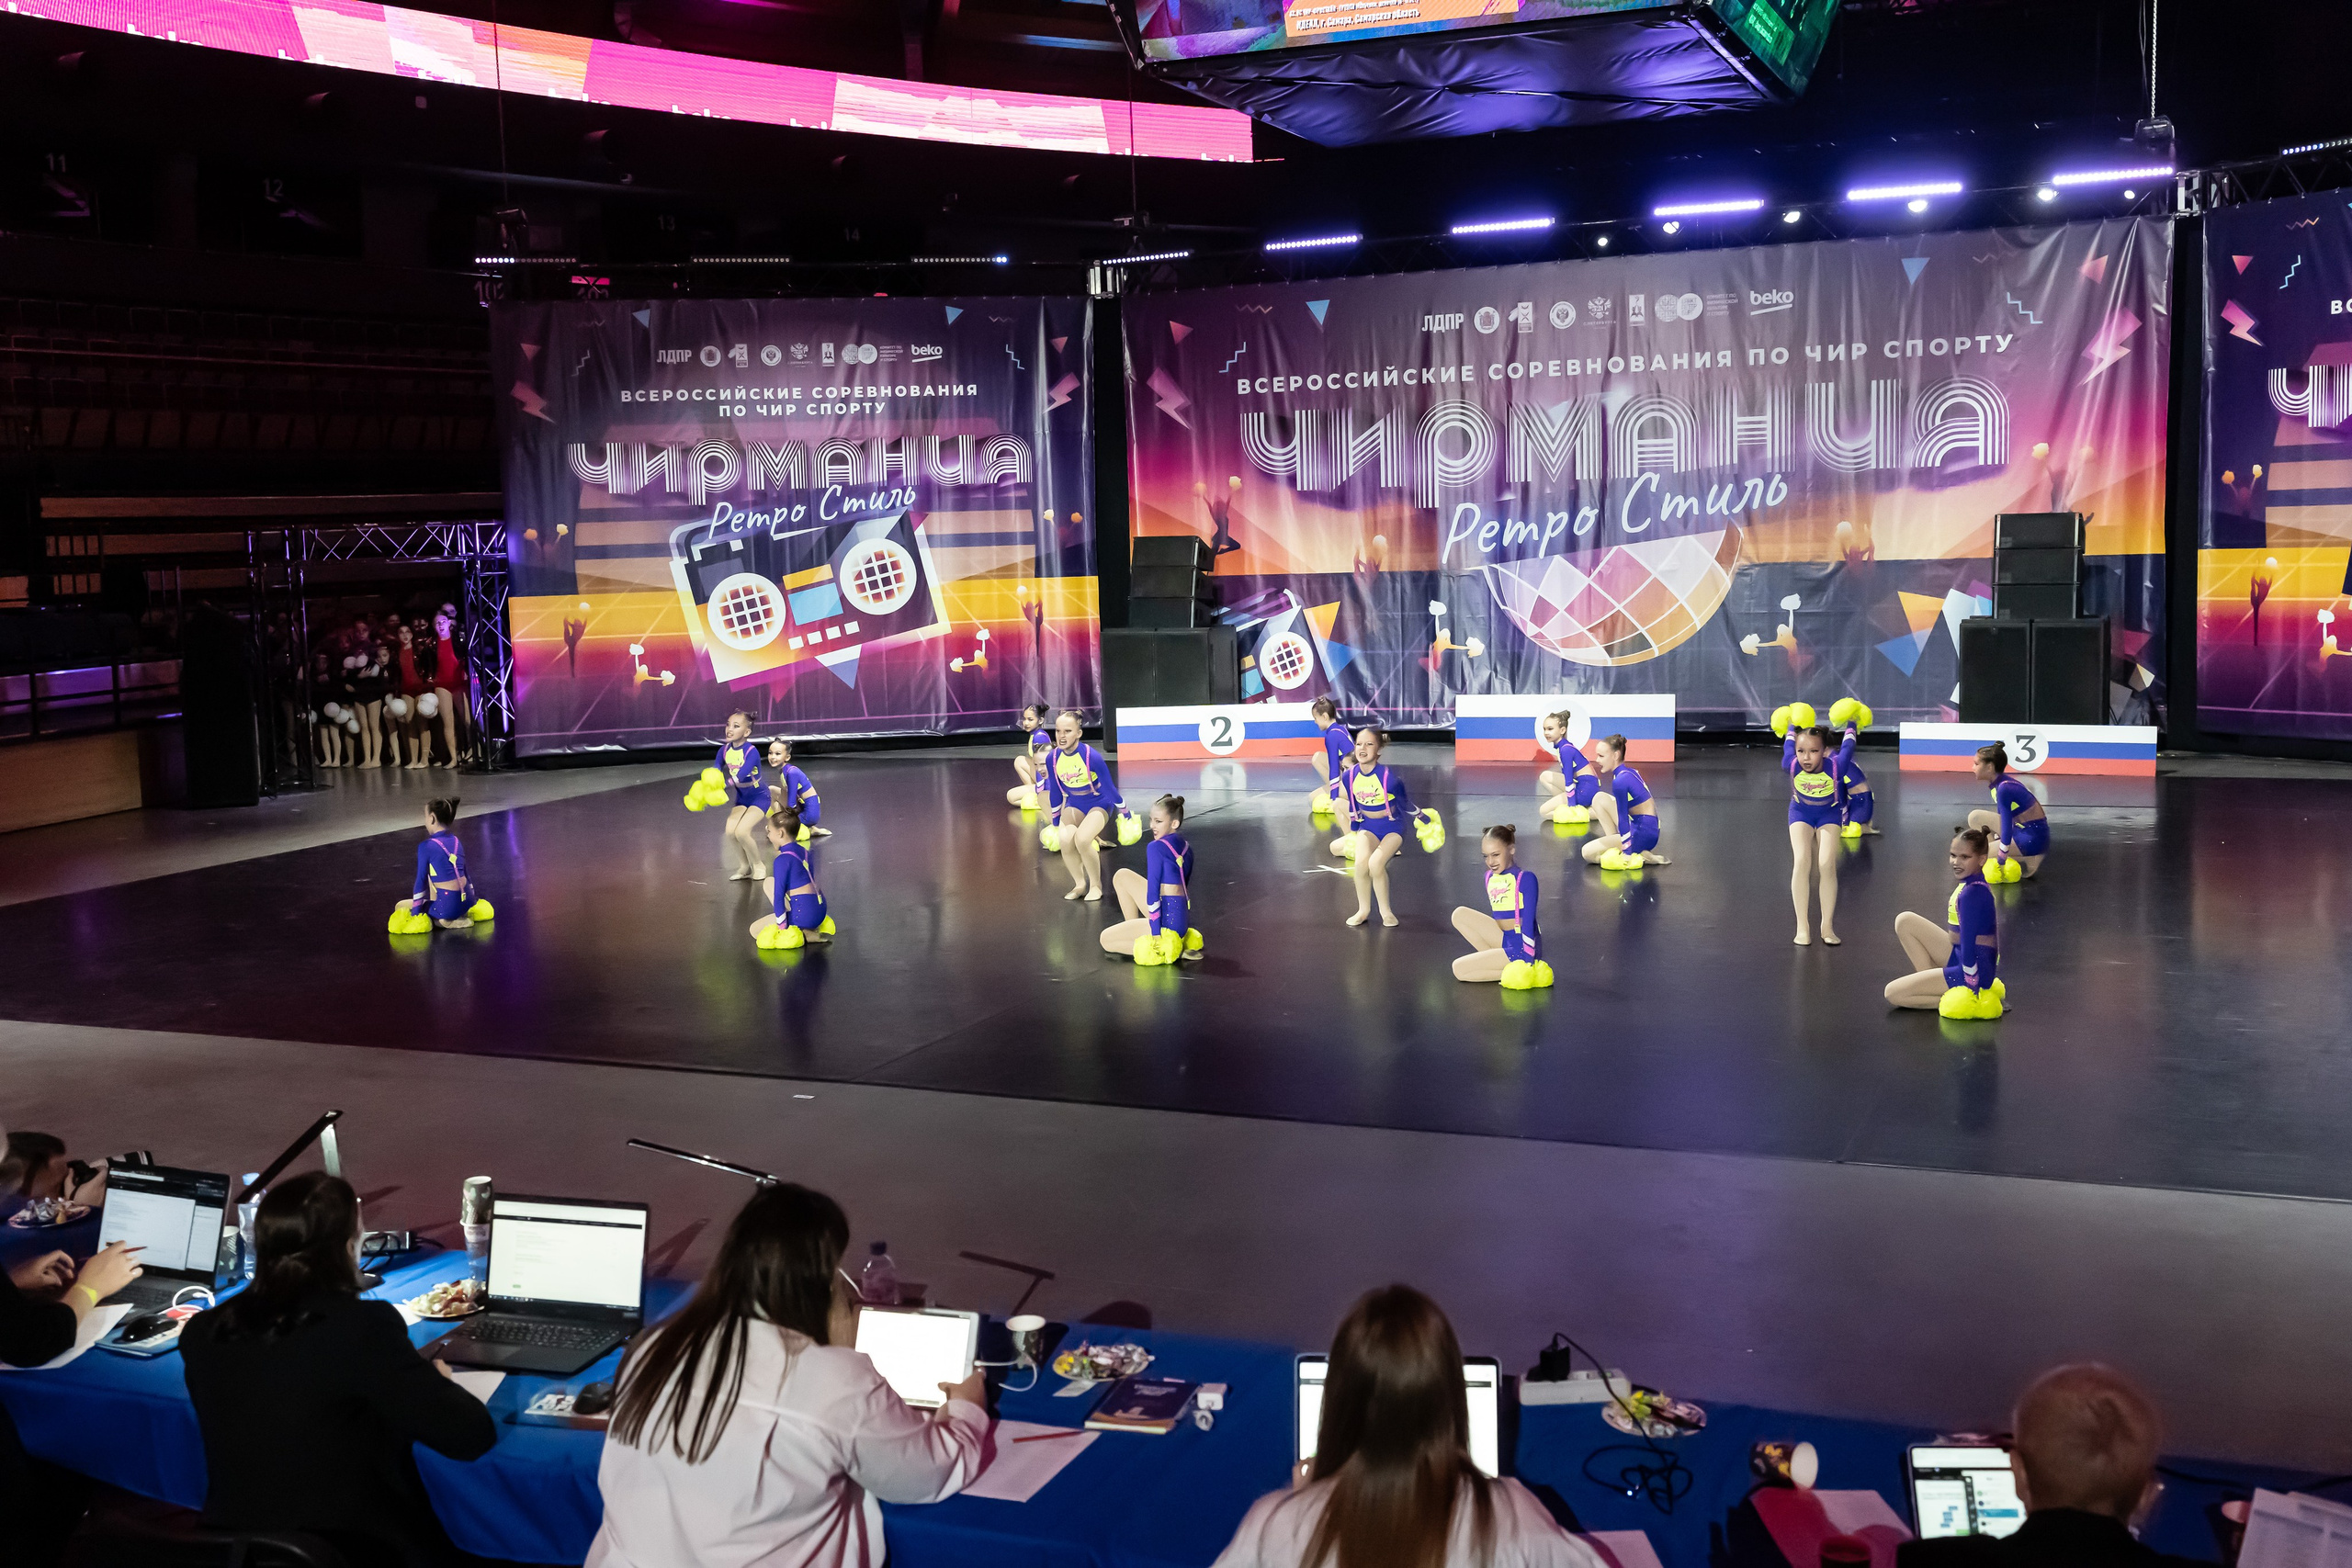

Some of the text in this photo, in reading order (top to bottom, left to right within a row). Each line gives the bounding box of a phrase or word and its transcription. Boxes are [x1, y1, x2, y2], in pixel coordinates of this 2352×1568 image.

[1749, 288, 1794, 306] beko
[1421, 312, 1464, 333] ЛДПР
[656, 349, 692, 365] ЛДПР
[910, 344, 944, 355] beko
[1238, 333, 2014, 395] ВСЕРОССИЙСКИЕ СОРЕВНОВАНИЯ ПО ЧИР СПОРТУ
[621, 384, 978, 402] ВСЕРОССИЙСКИЕ СОРЕВНОВАНИЯ
[718, 401, 887, 417] ПО ЧИР СПОРТУ
[708, 484, 917, 539] Ретро Стиль
[1441, 470, 1788, 566] Ретро Стиль
[1210, 716, 1233, 747] 2
[2015, 735, 2037, 763] 3
